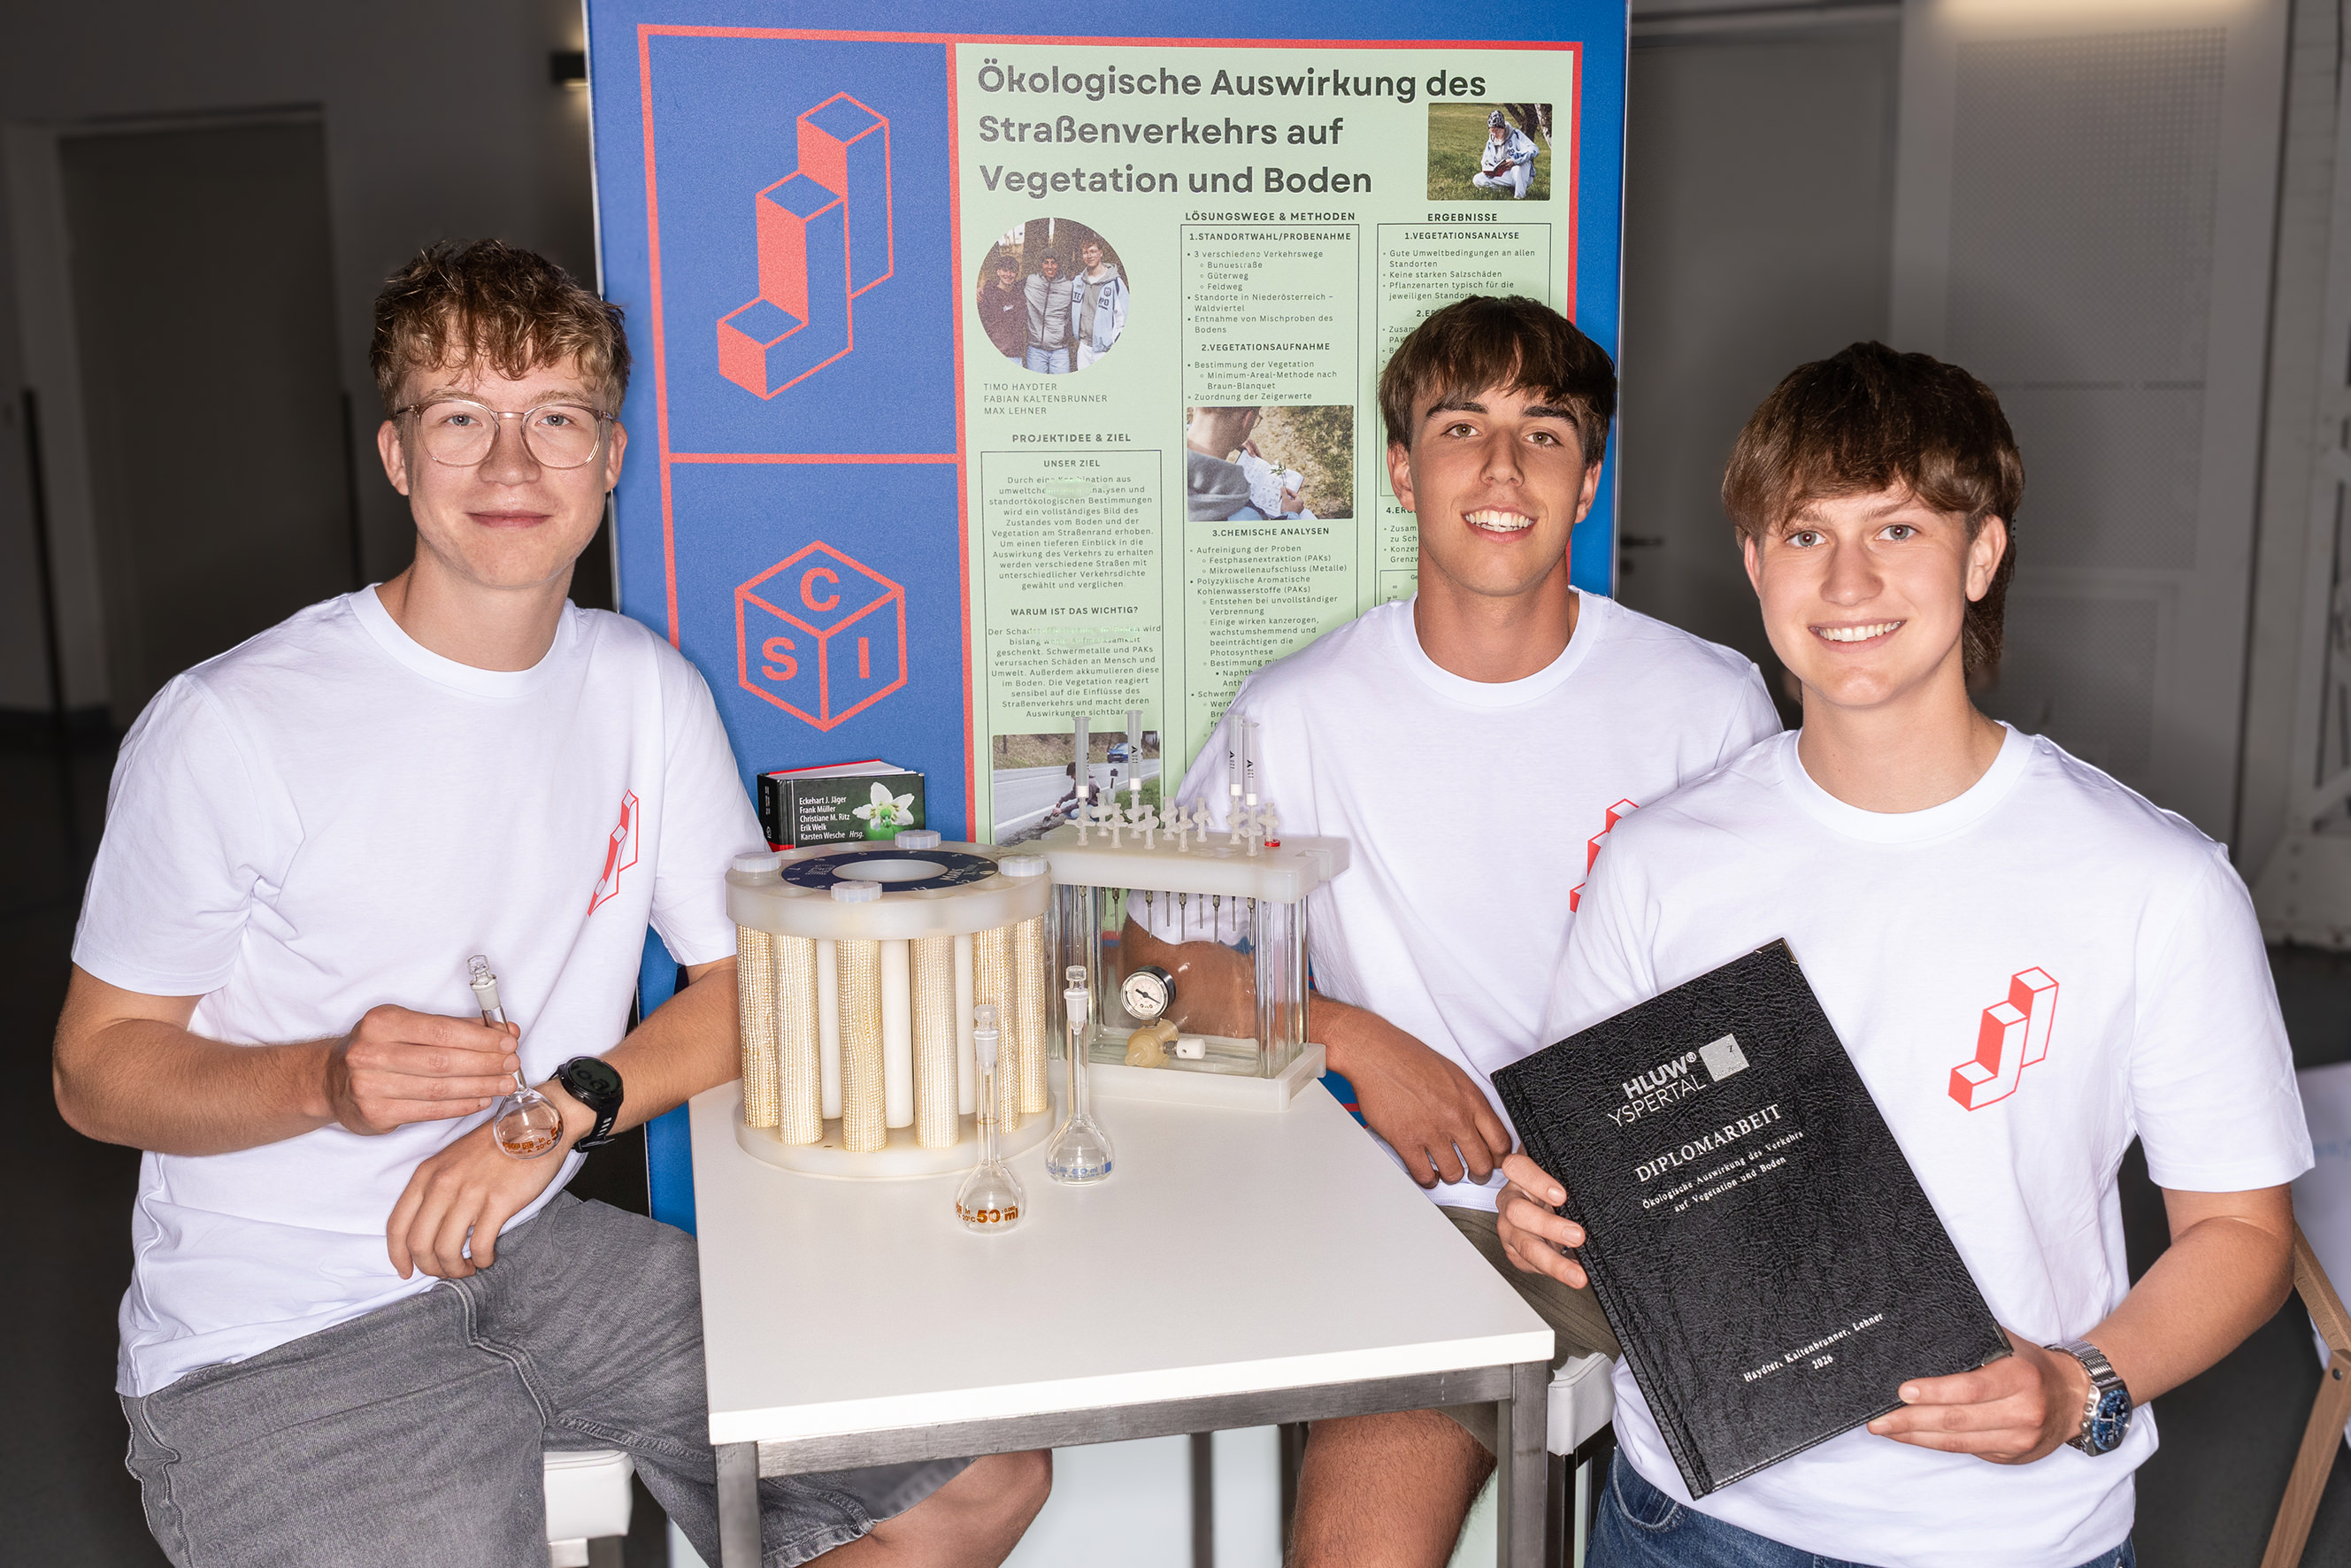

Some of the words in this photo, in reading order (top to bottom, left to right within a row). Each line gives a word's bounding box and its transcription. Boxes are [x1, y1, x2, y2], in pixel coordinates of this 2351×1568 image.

[979, 58, 1201, 101] Ökologische
[1210, 67, 1416, 104] Auswirkung
[1426, 70, 1487, 96] des
[980, 115, 1277, 144] Straßenverkehrs
[1287, 118, 1343, 144] auf
[980, 164, 1178, 199] Vegetation
[1189, 166, 1252, 193] und
[1265, 166, 1371, 193] Boden
[1185, 210, 1275, 221] LÖSUNGSWEGE
[1279, 211, 1287, 221] &
[1290, 211, 1356, 221] METHODEN
[1427, 212, 1498, 222] ERGEBNISSE
[1189, 232, 1351, 242] 1.STANDORTWAHL/PROBENAHME
[1404, 231, 1519, 240] 1.VEGETATIONSANALYSE
[1412, 249, 1500, 258] Umweltbedingungen
[1207, 272, 1249, 281] Güterweg
[1415, 270, 1448, 279] starken
[1449, 270, 1502, 279] Salzschäden
[1207, 282, 1243, 292] Feldweg
[1389, 281, 1449, 289] Pflanzenarten
[1451, 281, 1483, 290] typisch
[1194, 293, 1239, 302] Standorte
[1388, 291, 1433, 302] jeweiligen
[1194, 304, 1245, 312] Waldviertel
[1259, 314, 1316, 324] Mischproben
[1201, 342, 1330, 352] 2.VEGETATIONSAUFNAHME
[1194, 361, 1248, 370] Bestimmung
[1250, 360, 1265, 369] der
[1267, 360, 1315, 370] Vegetation
[1207, 370, 1314, 380] Minimum-Areal-Methode
[1317, 370, 1338, 379] nach
[983, 382, 1009, 391] TIMO
[1011, 382, 1057, 391] HAYDTER
[1207, 381, 1276, 391] Braun-Blanquet
[983, 395, 1019, 404] FABIAN
[1023, 394, 1108, 404] KALTENBRUNNER
[1194, 393, 1241, 403] Zuordnung
[1243, 392, 1259, 401] der
[1261, 392, 1312, 402] Zeigerwerte
[984, 406, 1005, 415] MAX
[1008, 406, 1047, 415] LEHNER
[1011, 434, 1092, 443] PROJEKTIDEE
[1095, 433, 1103, 442] &
[1106, 433, 1132, 442] ZIEL
[1043, 459, 1077, 468] UNSER
[988, 496, 1086, 506] standortökologischen
[1087, 496, 1153, 505] Bestimmungen
[991, 529, 1040, 539] Vegetation
[1057, 527, 1112, 537] Straßenrand
[1211, 527, 1278, 537] 3.CHEMISCHE
[1279, 527, 1330, 535] ANALYSEN
[992, 550, 1043, 560] Auswirkung
[1063, 549, 1103, 557] Verkehrs
[1196, 546, 1252, 556] Aufreinigung
[999, 560, 1033, 569] werden
[1095, 558, 1131, 567] Straßen
[1209, 555, 1302, 565] Festphasenextraktion
[1304, 554, 1332, 563] (PAKs)
[1209, 565, 1307, 574] Mikrowellenaufschluss
[1309, 564, 1348, 573] (Metalle)
[998, 571, 1078, 580] unterschiedlicher
[1079, 569, 1146, 578] Verkehrsdichte
[1021, 581, 1056, 591] gewählt
[1058, 580, 1075, 589] und
[1196, 576, 1255, 587] Polyzyklische
[1256, 575, 1310, 584] Aromatische
[800, 567, 841, 612] C
[1196, 586, 1281, 596] Kohlenwasserstoffe
[1283, 585, 1311, 594] (PAKs)
[1271, 595, 1339, 604] unvollständiger
[1050, 607, 1066, 616] IST
[1090, 605, 1139, 615] WICHTIG?
[1209, 608, 1265, 617] Verbrennung
[1210, 618, 1236, 627] Einige
[1238, 617, 1266, 626] wirken
[1209, 626, 1298, 636] wachstumshemmend
[1300, 626, 1317, 634] und
[1210, 637, 1278, 647] beeinträchtigen
[1210, 648, 1274, 658] Photosynthese
[762, 636, 798, 681] S
[1002, 699, 1074, 708] Straßenverkehrs
[1095, 697, 1122, 706] macht
[1026, 709, 1087, 719] Auswirkungen
[798, 796, 826, 806] Eckehart
[830, 796, 848, 805] Jäger
[799, 805, 817, 814] Frank
[817, 804, 836, 813] Müller
[799, 814, 830, 824] Christiane
[838, 812, 850, 821] Ritz
[800, 823, 812, 833] Erik
[811, 822, 827, 832] Welk
[800, 832, 824, 841] Karsten
[823, 830, 846, 840] Wesche
[1607, 1074, 1707, 1127] YSPERTAL
[1634, 1103, 1781, 1182] DIPLOMARBEIT
[1642, 1182, 1694, 1210] Ökologische
[1696, 1158, 1746, 1184] Auswirkung
[1748, 1149, 1763, 1161] des
[1765, 1131, 1804, 1151] Verkehrs
[1674, 1201, 1689, 1213] auf
[1692, 1178, 1738, 1203] Vegetation
[1740, 1170, 1757, 1182] und
[1759, 1157, 1786, 1173] Boden
[976, 1209, 1001, 1224] 50
[1004, 1207, 1018, 1222] ml
[1743, 1361, 1784, 1382] Haydter,
[1784, 1329, 1851, 1364] Kaltenbrunner,
[1852, 1313, 1884, 1332] Lehner
[1811, 1354, 1833, 1370] 2026
